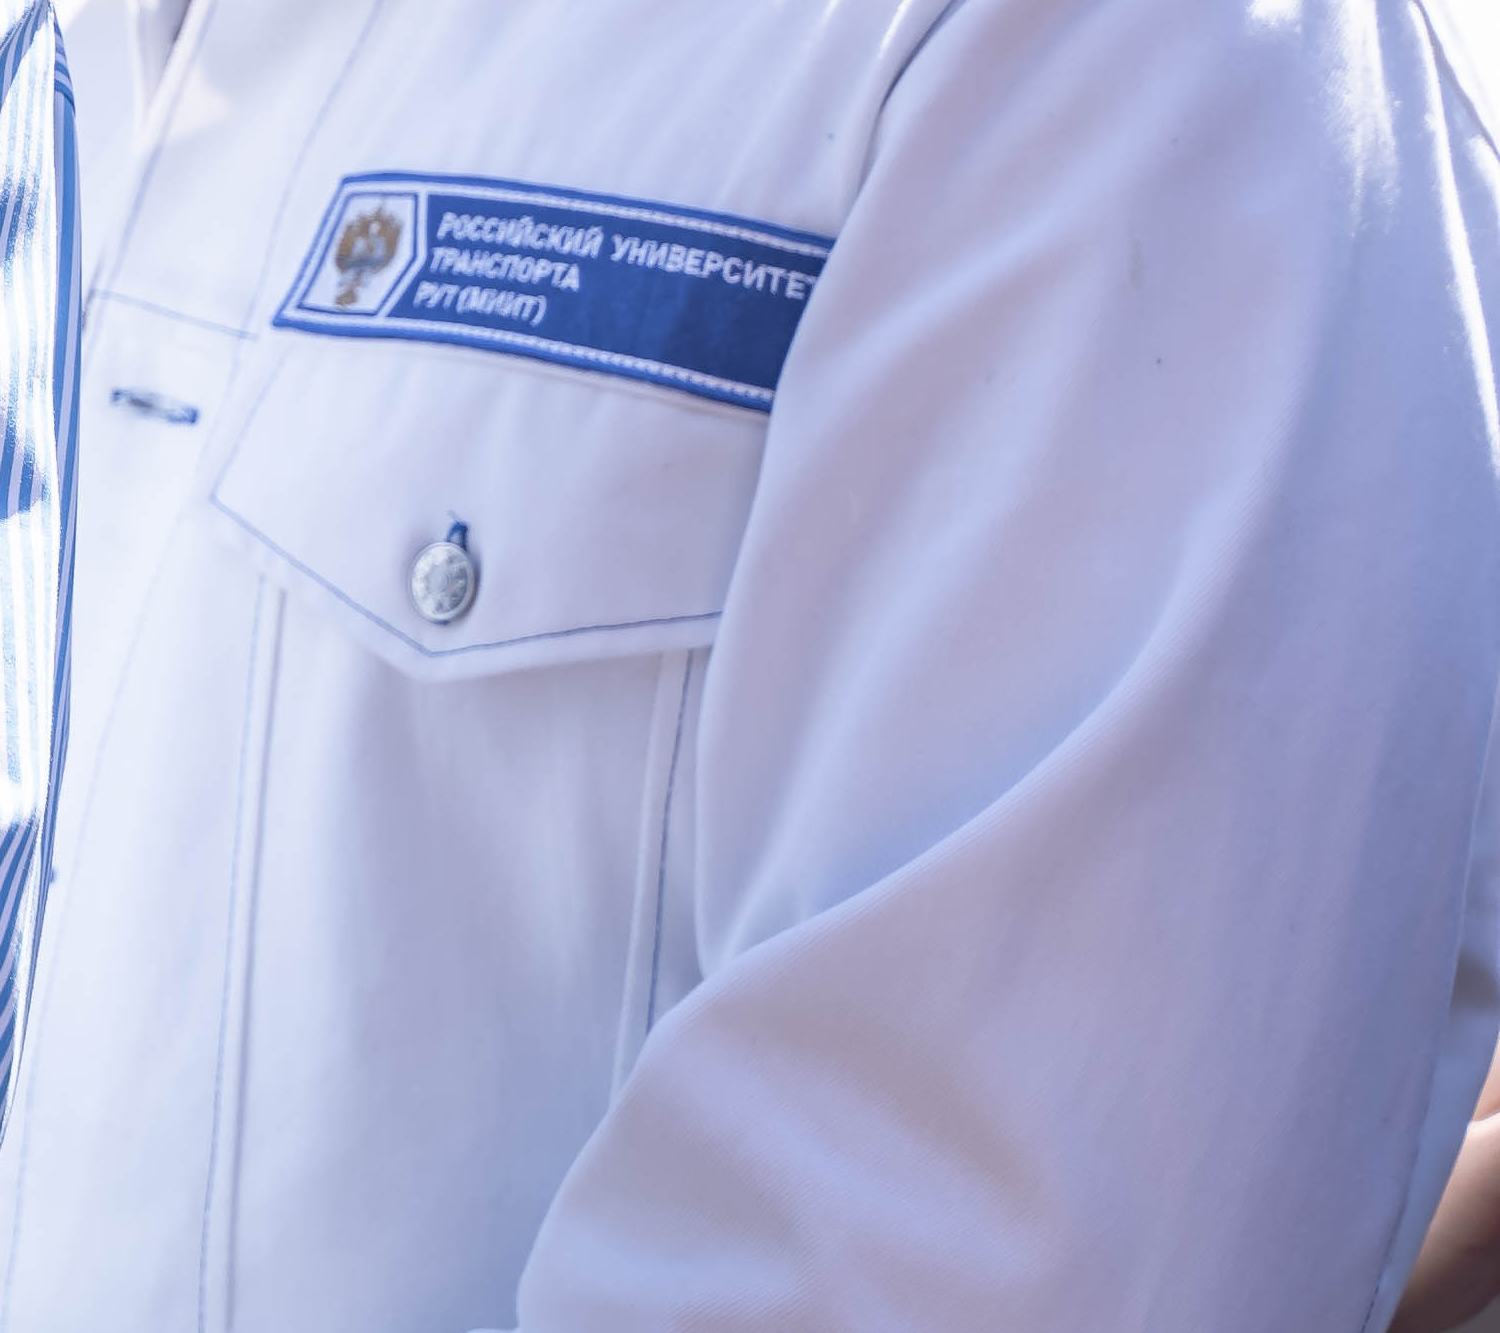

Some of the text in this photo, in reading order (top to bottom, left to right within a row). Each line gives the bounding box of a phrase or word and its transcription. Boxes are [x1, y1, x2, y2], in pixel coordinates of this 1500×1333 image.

[429, 245, 580, 293] ТРАНСПОРТА
[436, 211, 818, 300] РОССИЙСКИЙ УНИВЕРСИТЕ
